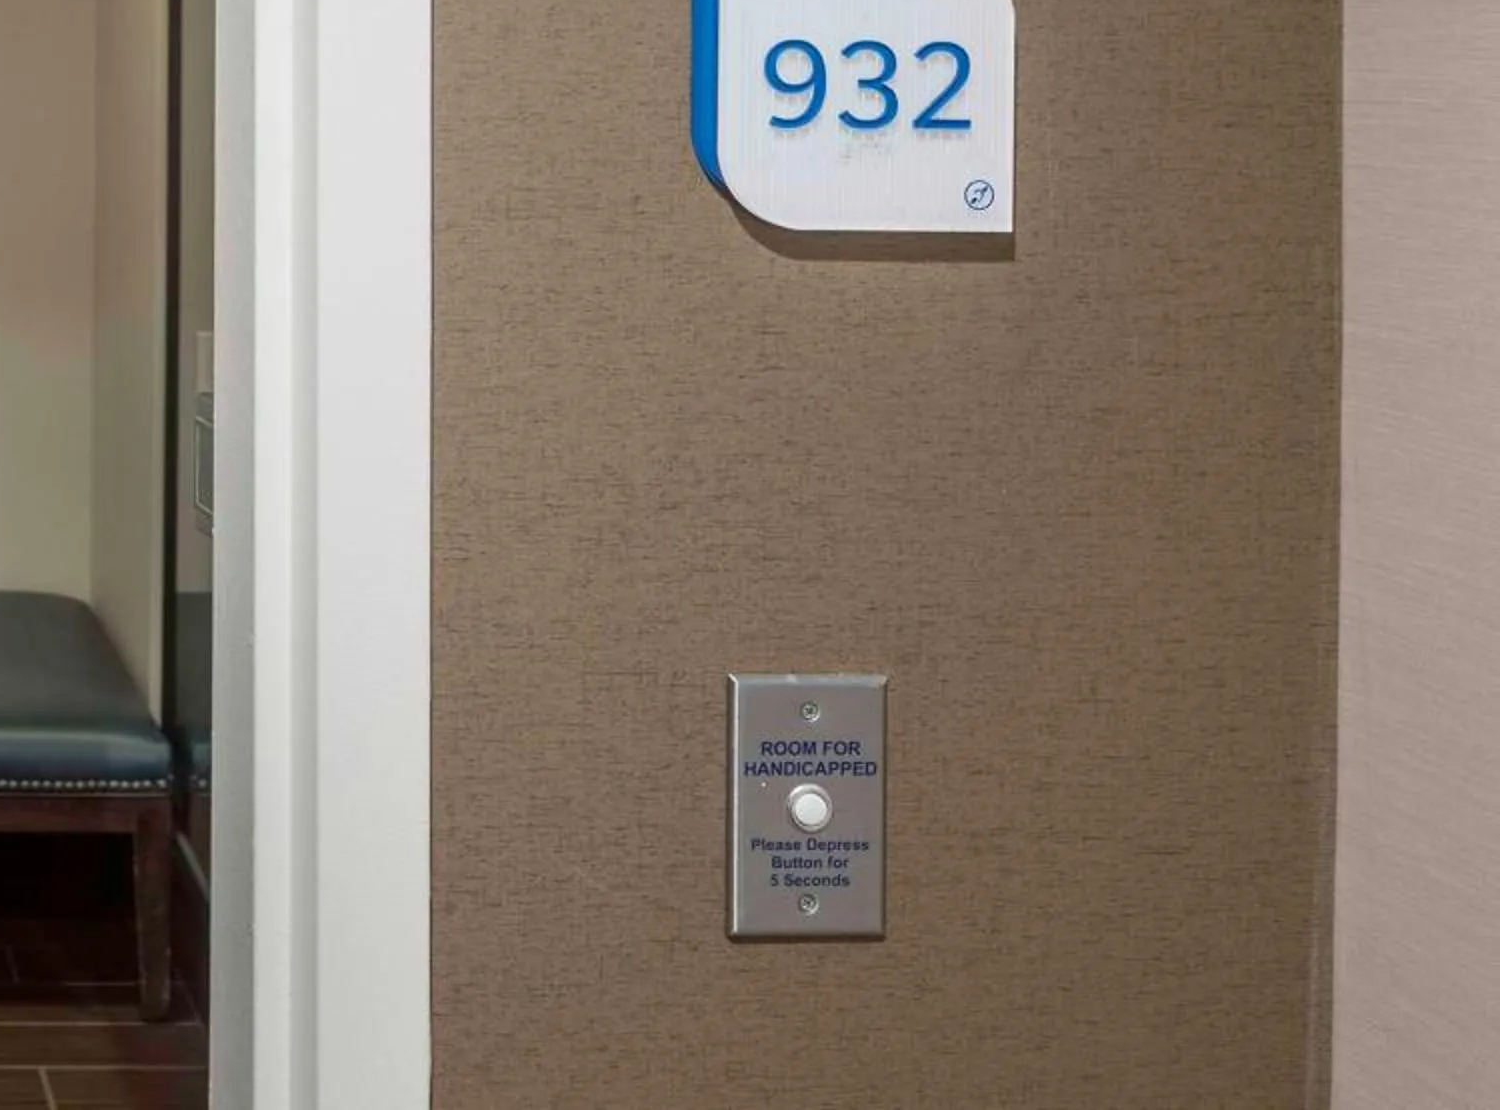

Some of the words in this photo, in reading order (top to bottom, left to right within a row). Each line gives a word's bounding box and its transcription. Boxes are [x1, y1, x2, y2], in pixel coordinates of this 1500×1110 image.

[763, 38, 972, 130] 932
[760, 740, 817, 757] ROOM
[822, 740, 861, 757] FOR
[743, 761, 878, 777] HANDICAPPED
[750, 838, 801, 852] Please
[806, 838, 870, 854] Depress
[771, 856, 823, 870] Button
[827, 856, 849, 870] for
[770, 874, 779, 888] 5
[783, 874, 851, 888] Seconds
